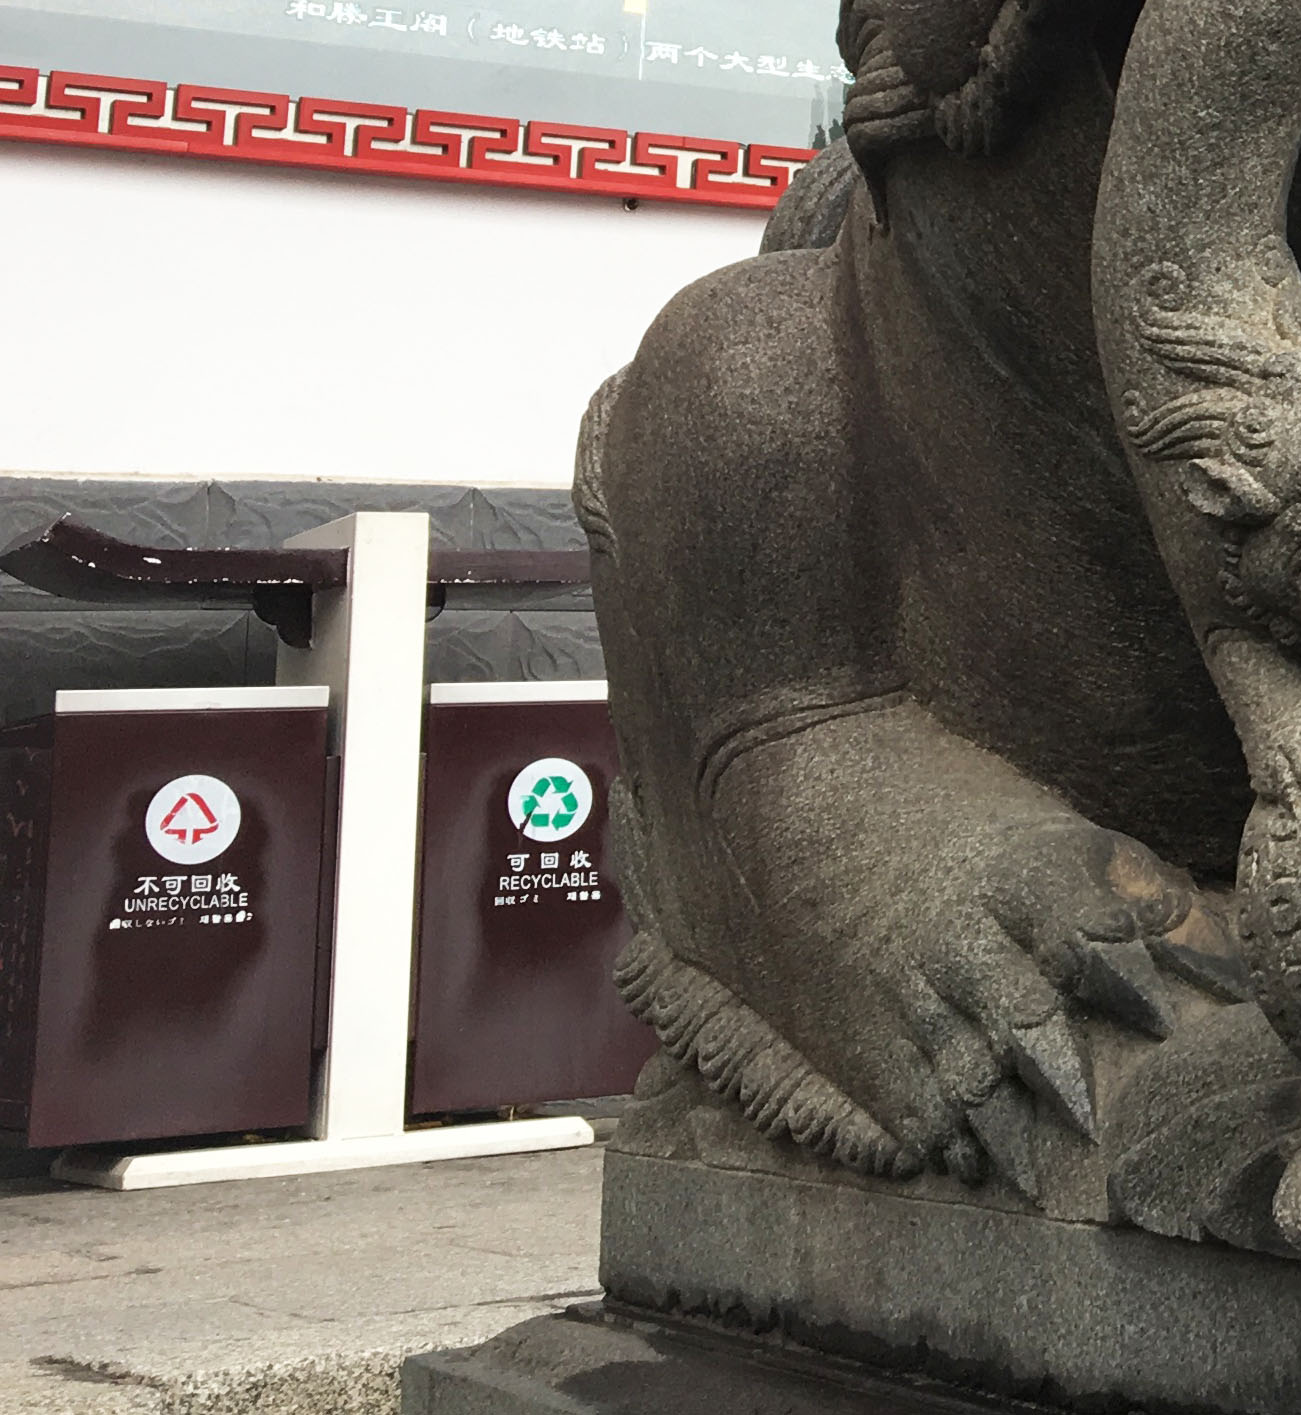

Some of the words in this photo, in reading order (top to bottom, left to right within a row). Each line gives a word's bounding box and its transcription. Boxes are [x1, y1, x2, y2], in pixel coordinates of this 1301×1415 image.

[507, 850, 592, 872] 可回收
[133, 872, 241, 895] 不可回收
[499, 871, 599, 890] RECYCLABLE
[124, 892, 249, 913] UNRECYCLABLE
